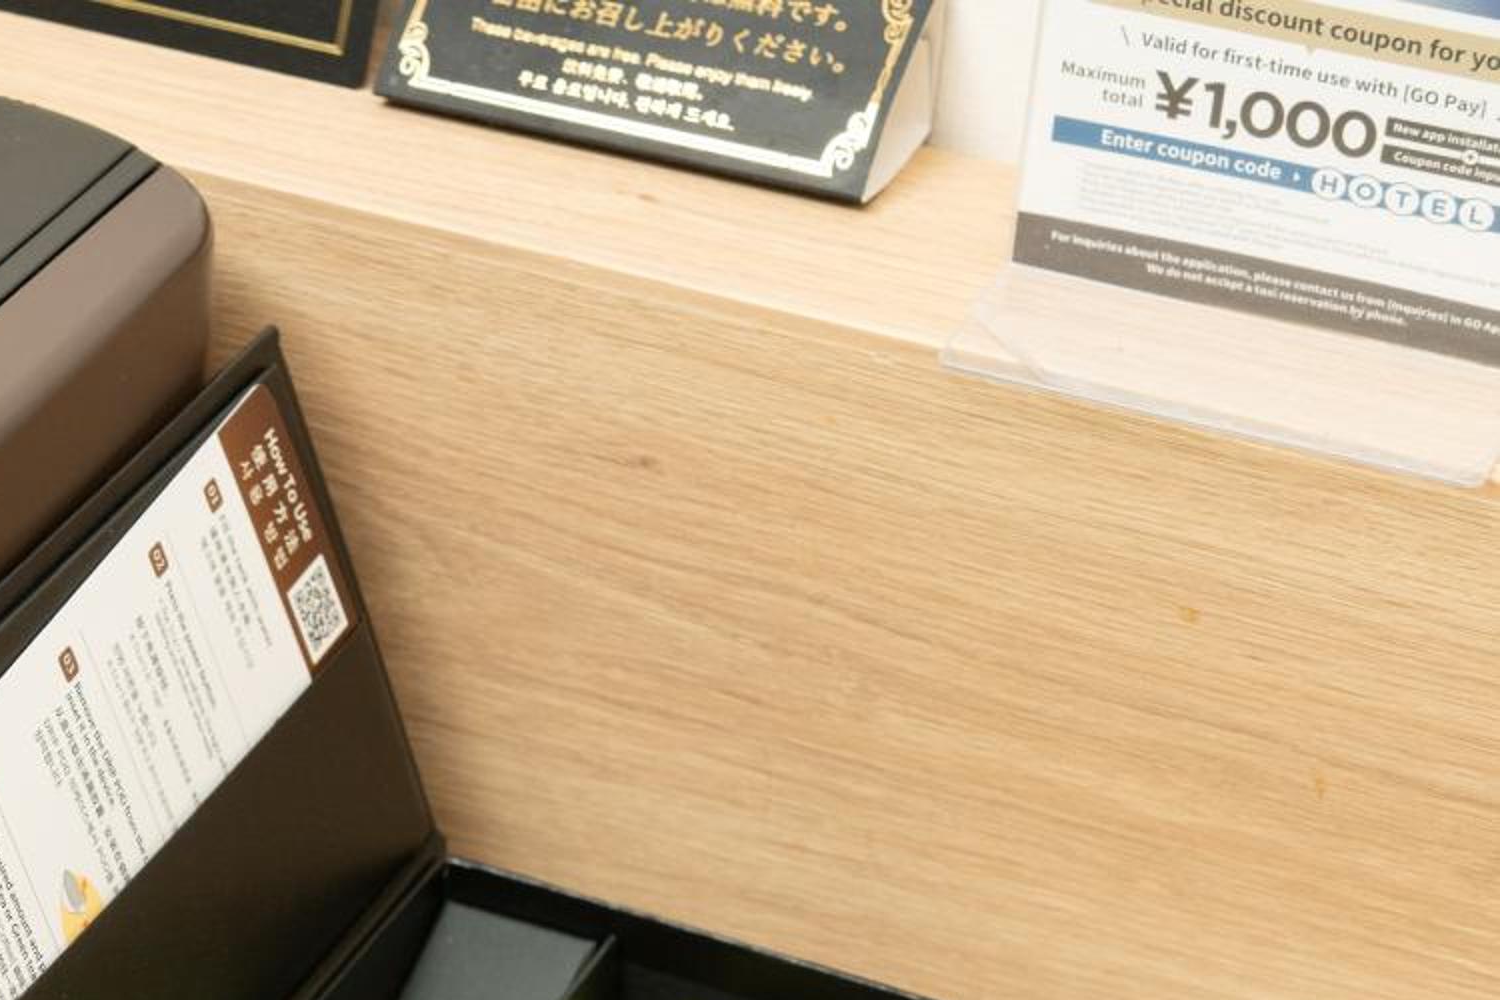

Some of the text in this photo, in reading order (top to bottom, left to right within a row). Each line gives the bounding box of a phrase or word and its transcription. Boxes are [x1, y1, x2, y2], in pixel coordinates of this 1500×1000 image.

[492, 0, 845, 74] にお召し上がりください。
[1219, 0, 1324, 36] discount
[1330, 24, 1422, 55] coupon
[1429, 39, 1465, 63] for
[1061, 60, 1146, 89] Maximum
[1141, 32, 1187, 54] Valid
[1192, 41, 1219, 61] for
[1223, 48, 1313, 80] first-time
[1317, 71, 1351, 88] use
[1355, 77, 1398, 98] with
[1102, 89, 1143, 108] total
[1155, 70, 1376, 158] ¥1,000
[1101, 129, 1282, 180] Enter coupon code
[263, 428, 312, 542] How To Use
